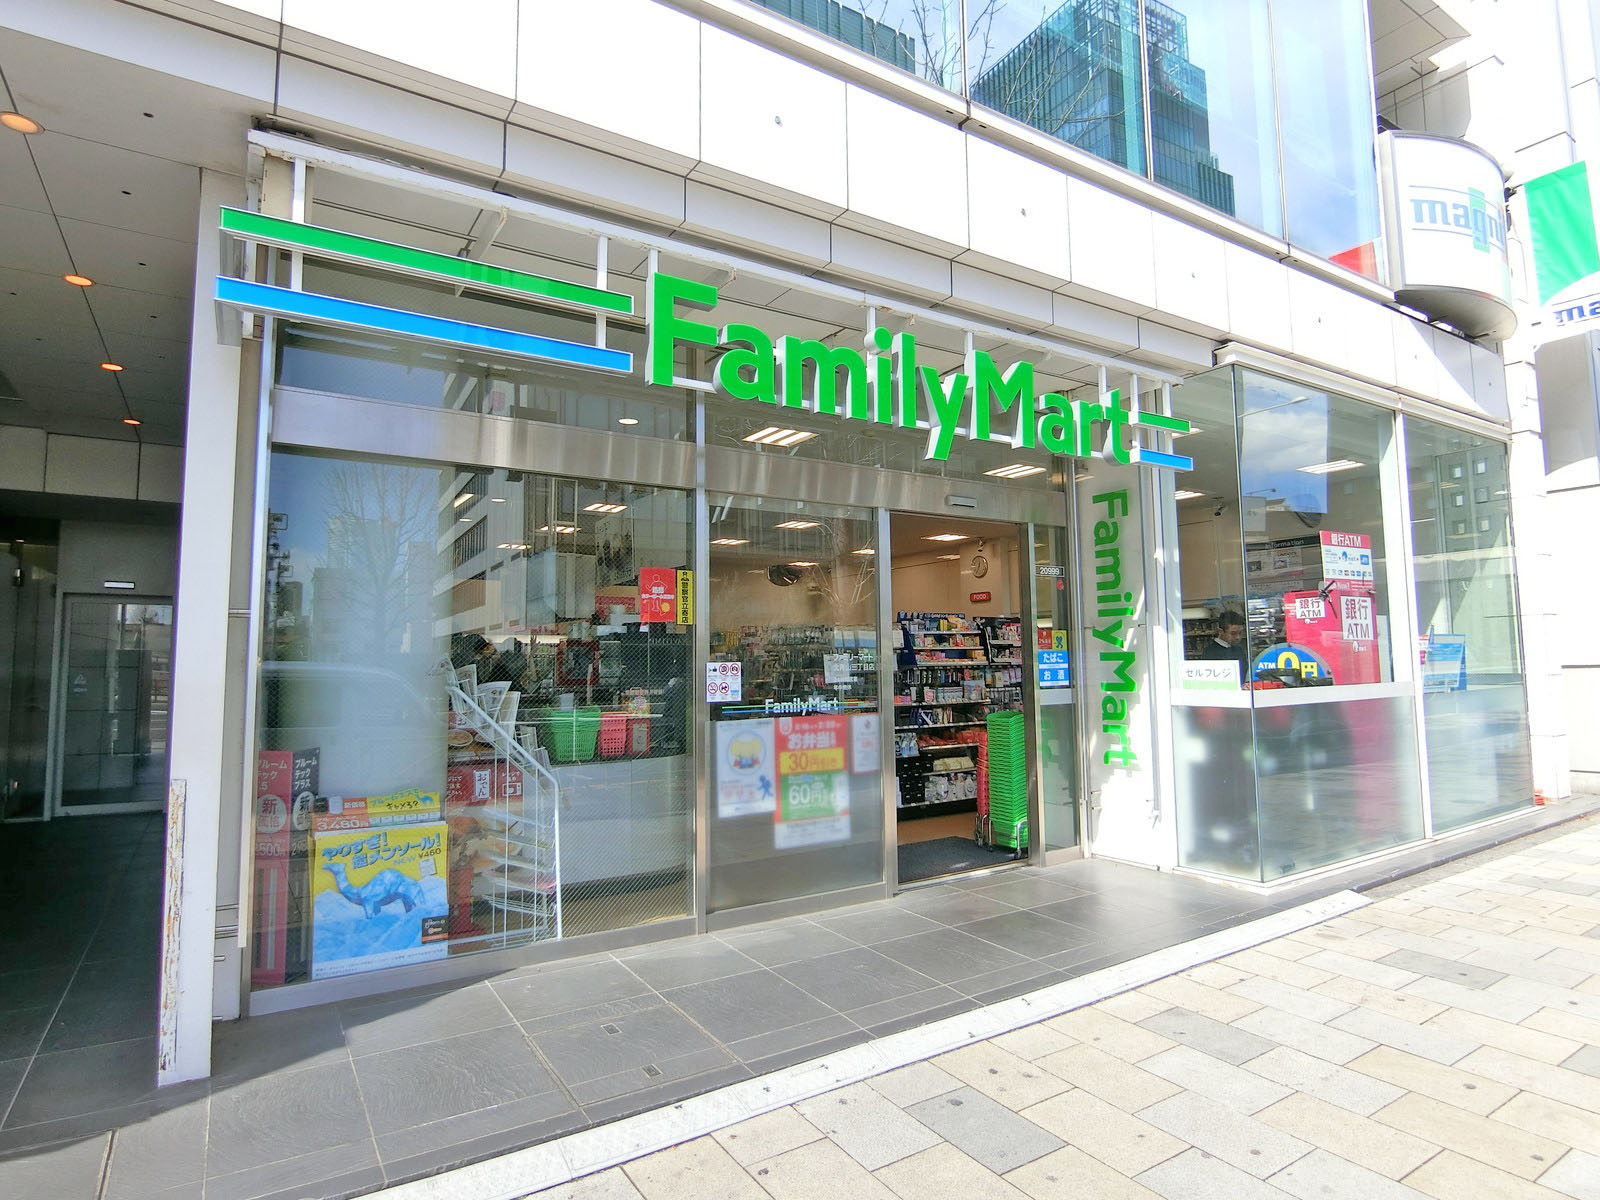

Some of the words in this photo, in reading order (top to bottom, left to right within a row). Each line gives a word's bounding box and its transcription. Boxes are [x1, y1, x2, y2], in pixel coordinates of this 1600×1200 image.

[646, 272, 1130, 465] FamilyMart
[1264, 539, 1305, 549] Information
[1331, 533, 1361, 546] 銀行ATM
[1040, 567, 1060, 575] 20999
[1299, 599, 1321, 609] 銀行
[1345, 598, 1368, 620] 銀行
[1300, 609, 1322, 618] ATM
[1092, 489, 1137, 767] FamilyMart
[1347, 623, 1370, 639] ATM
[832, 653, 874, 661] ファミリーマート
[1043, 652, 1063, 662] たばこ
[1185, 668, 1231, 678] セルフレジ
[765, 697, 839, 715] FamilyMart
[262, 798, 277, 815] 新
[418, 847, 442, 859] ¥460
